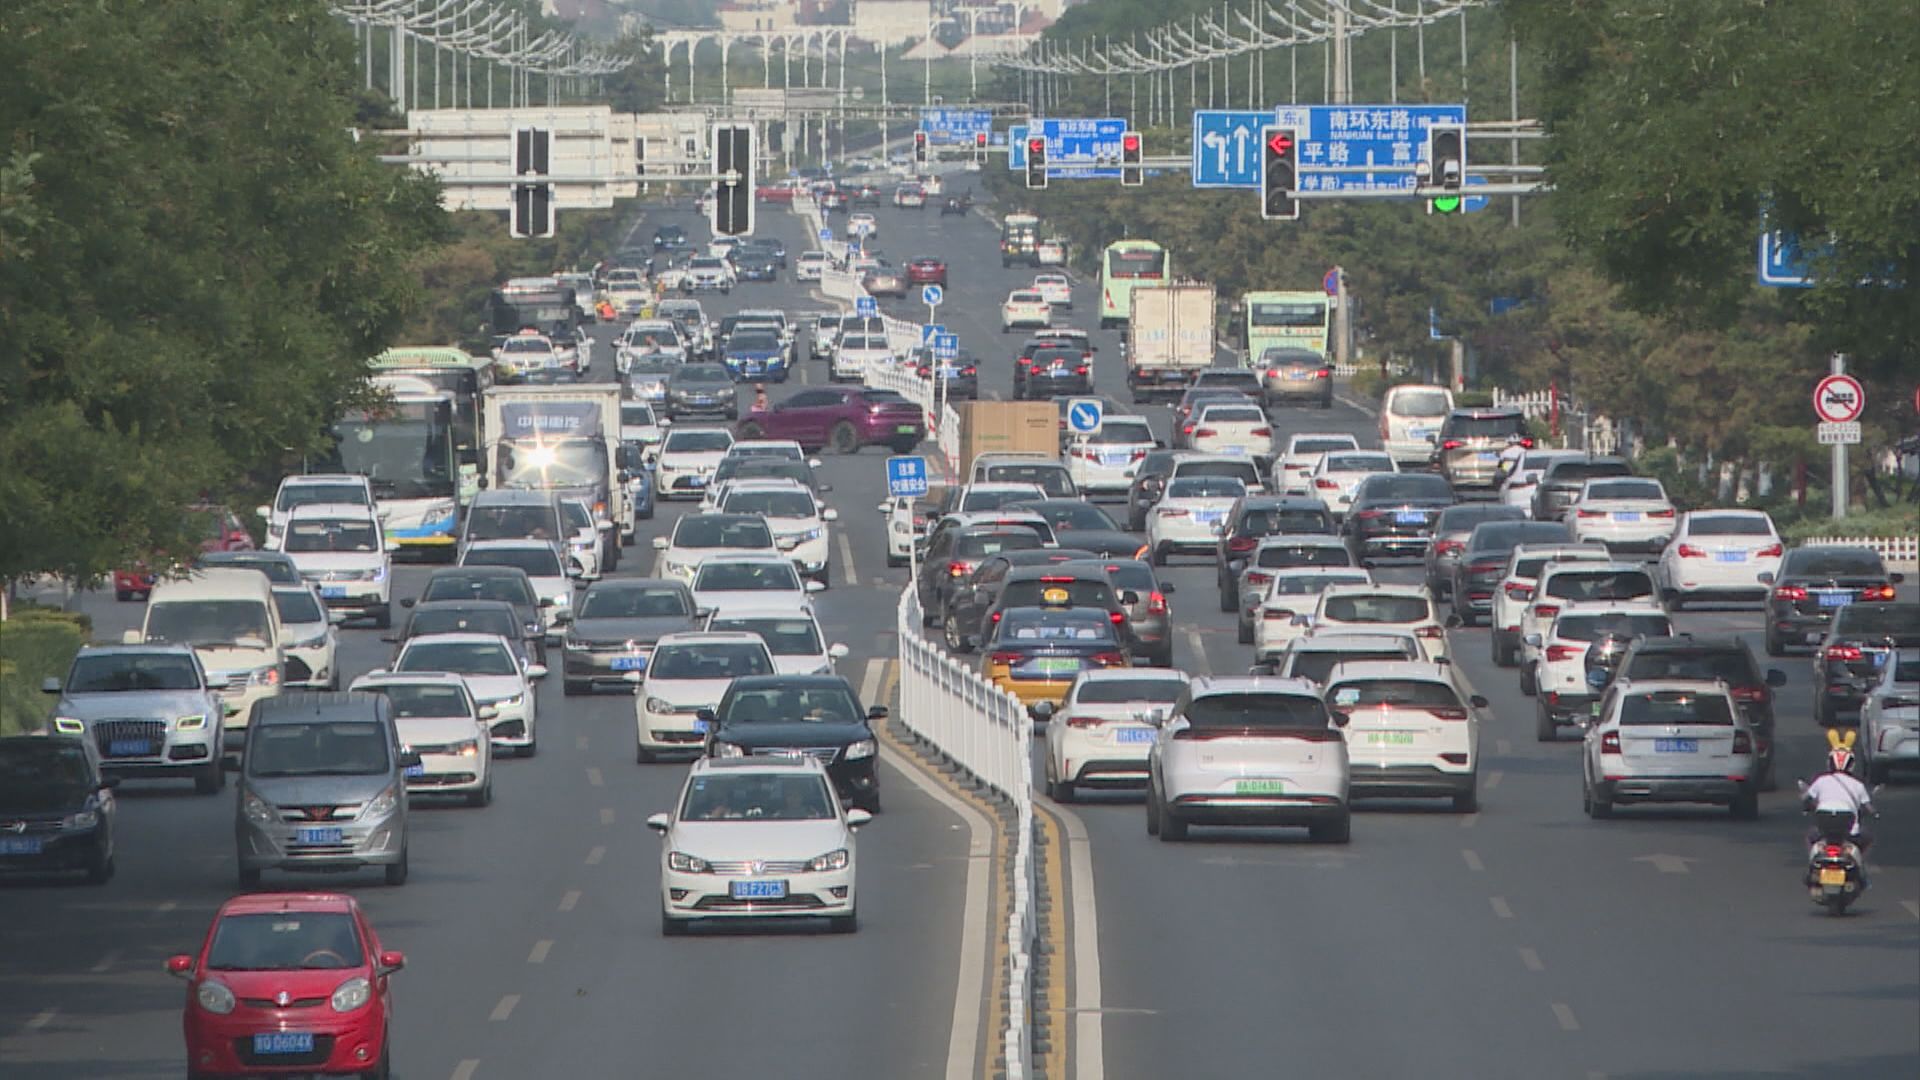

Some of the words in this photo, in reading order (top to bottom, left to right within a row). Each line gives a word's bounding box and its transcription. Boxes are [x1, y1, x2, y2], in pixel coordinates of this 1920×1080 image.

[1284, 111, 1296, 125] 东
[1329, 110, 1409, 130] 南环东路
[1377, 131, 1394, 140] East
[1398, 131, 1409, 140] Rd
[517, 414, 580, 429] 中国重汽
[898, 463, 915, 475] 注意
[891, 478, 926, 492] 交通安全
